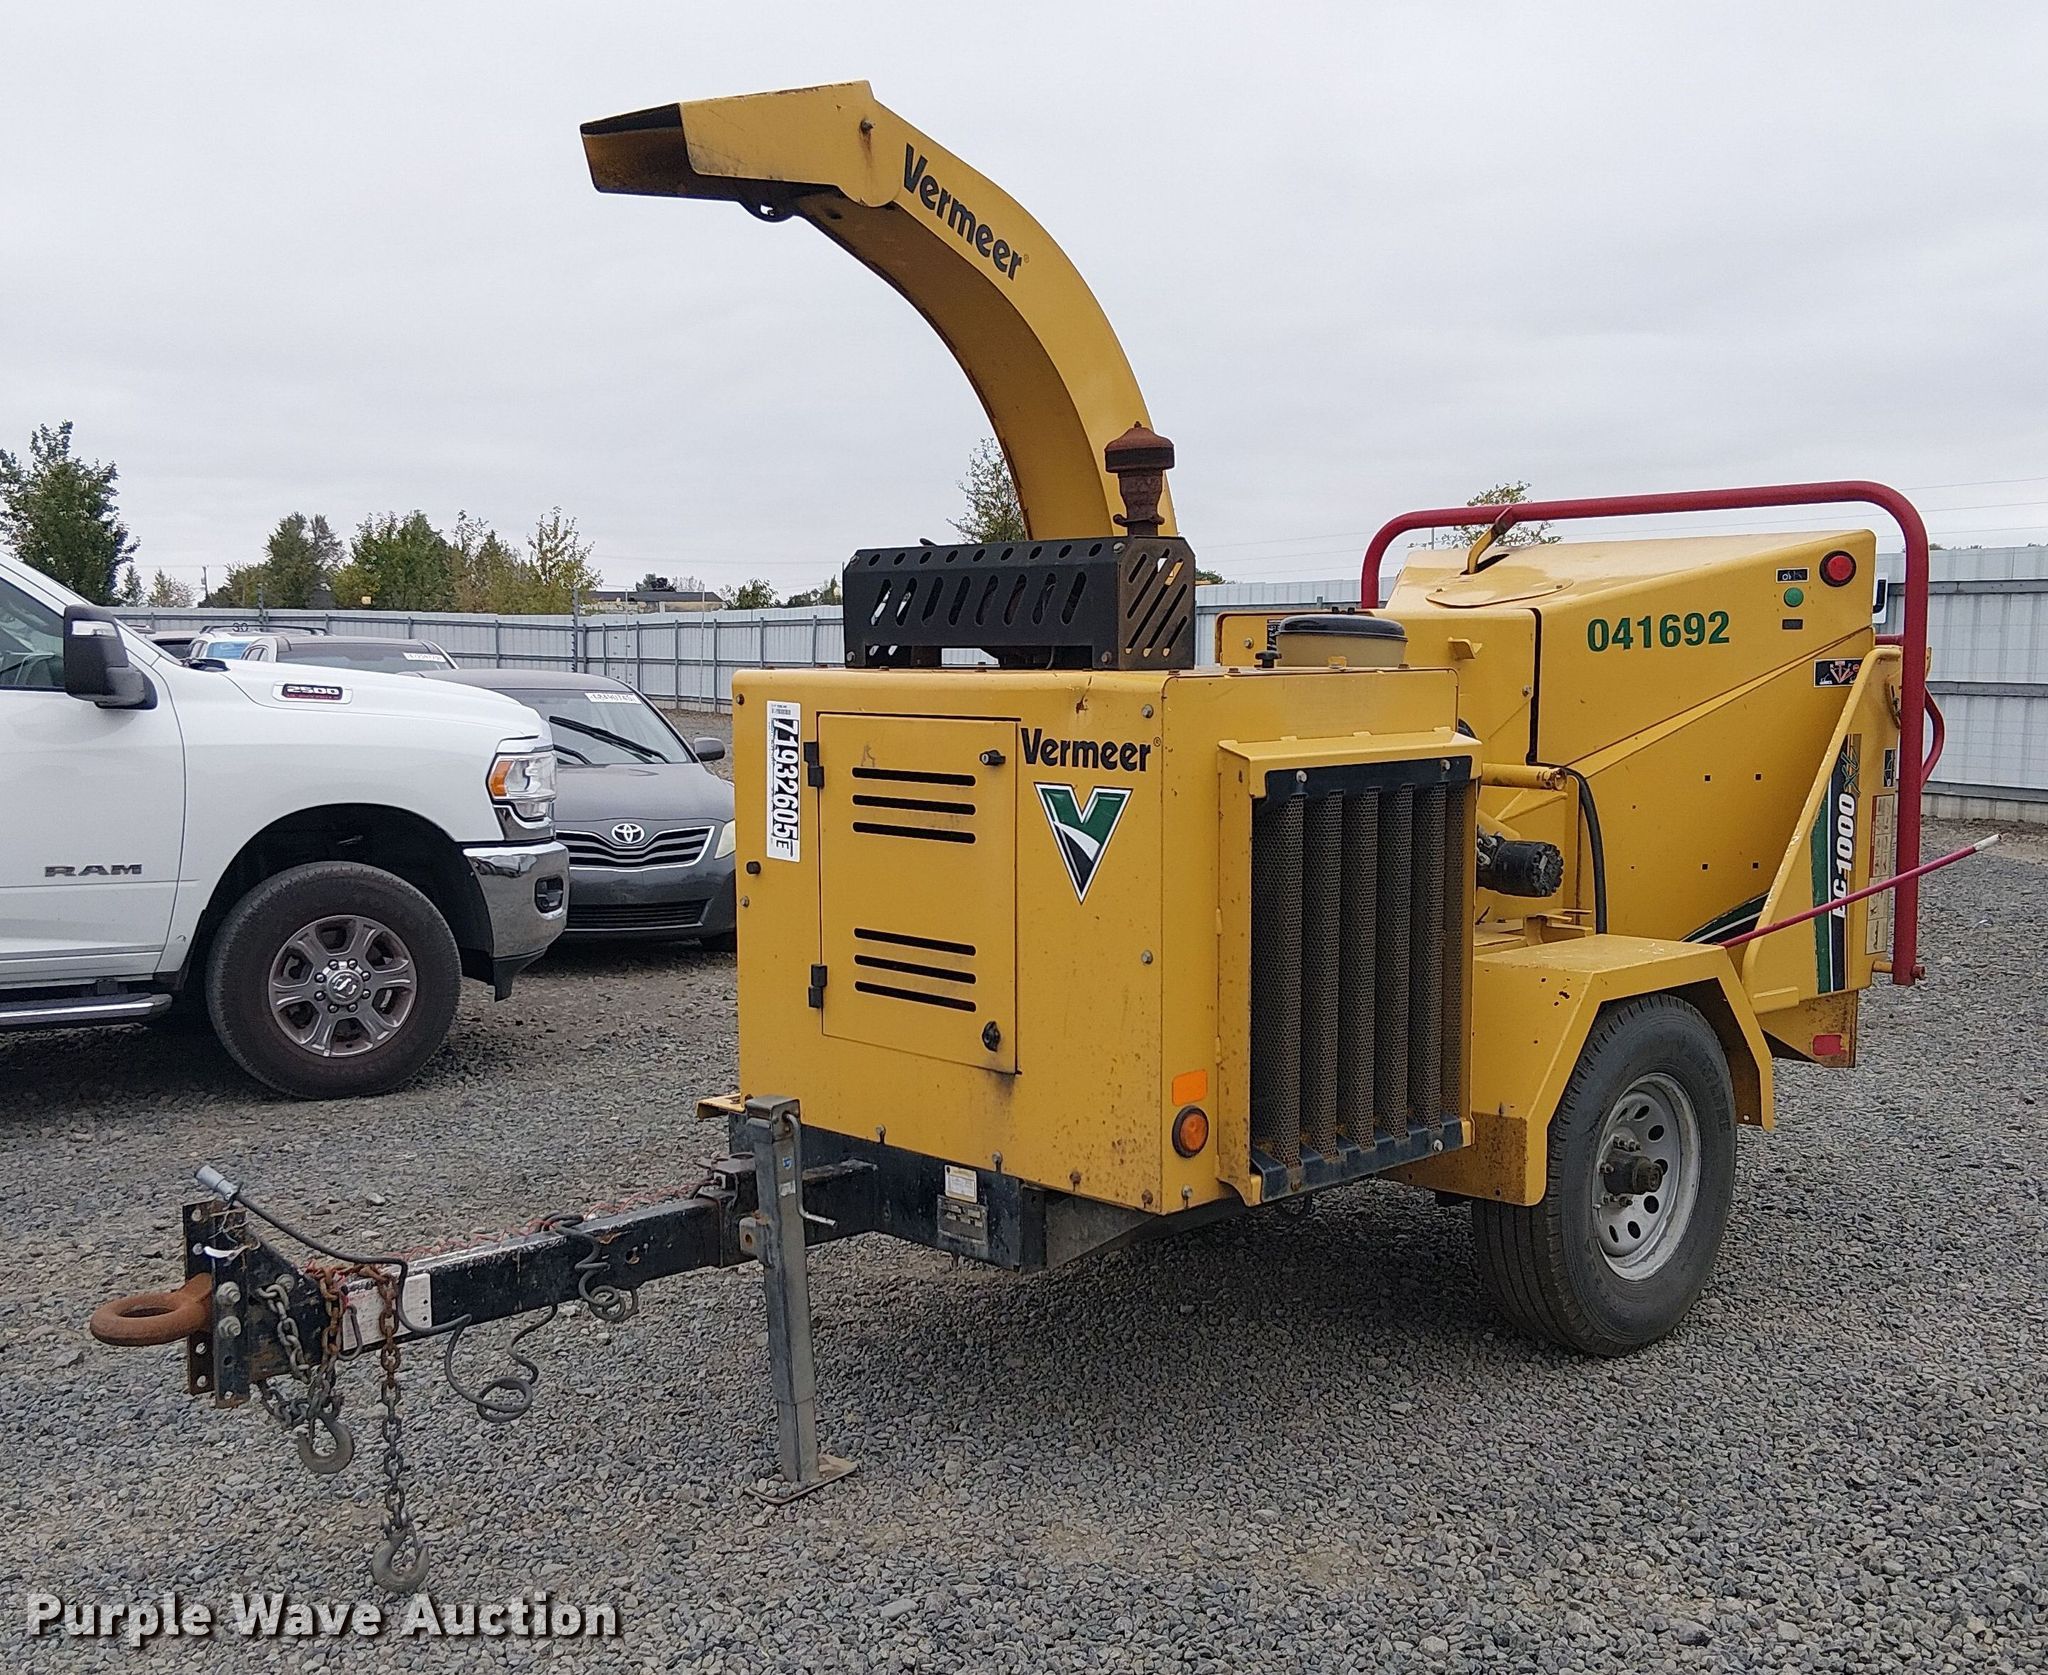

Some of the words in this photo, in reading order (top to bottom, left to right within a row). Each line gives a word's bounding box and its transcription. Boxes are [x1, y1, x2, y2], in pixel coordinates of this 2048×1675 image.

[1587, 610, 1730, 652] 041692
[286, 686, 340, 696] 2500
[1836, 793, 1856, 872] 1000
[45, 864, 142, 877] RAM
